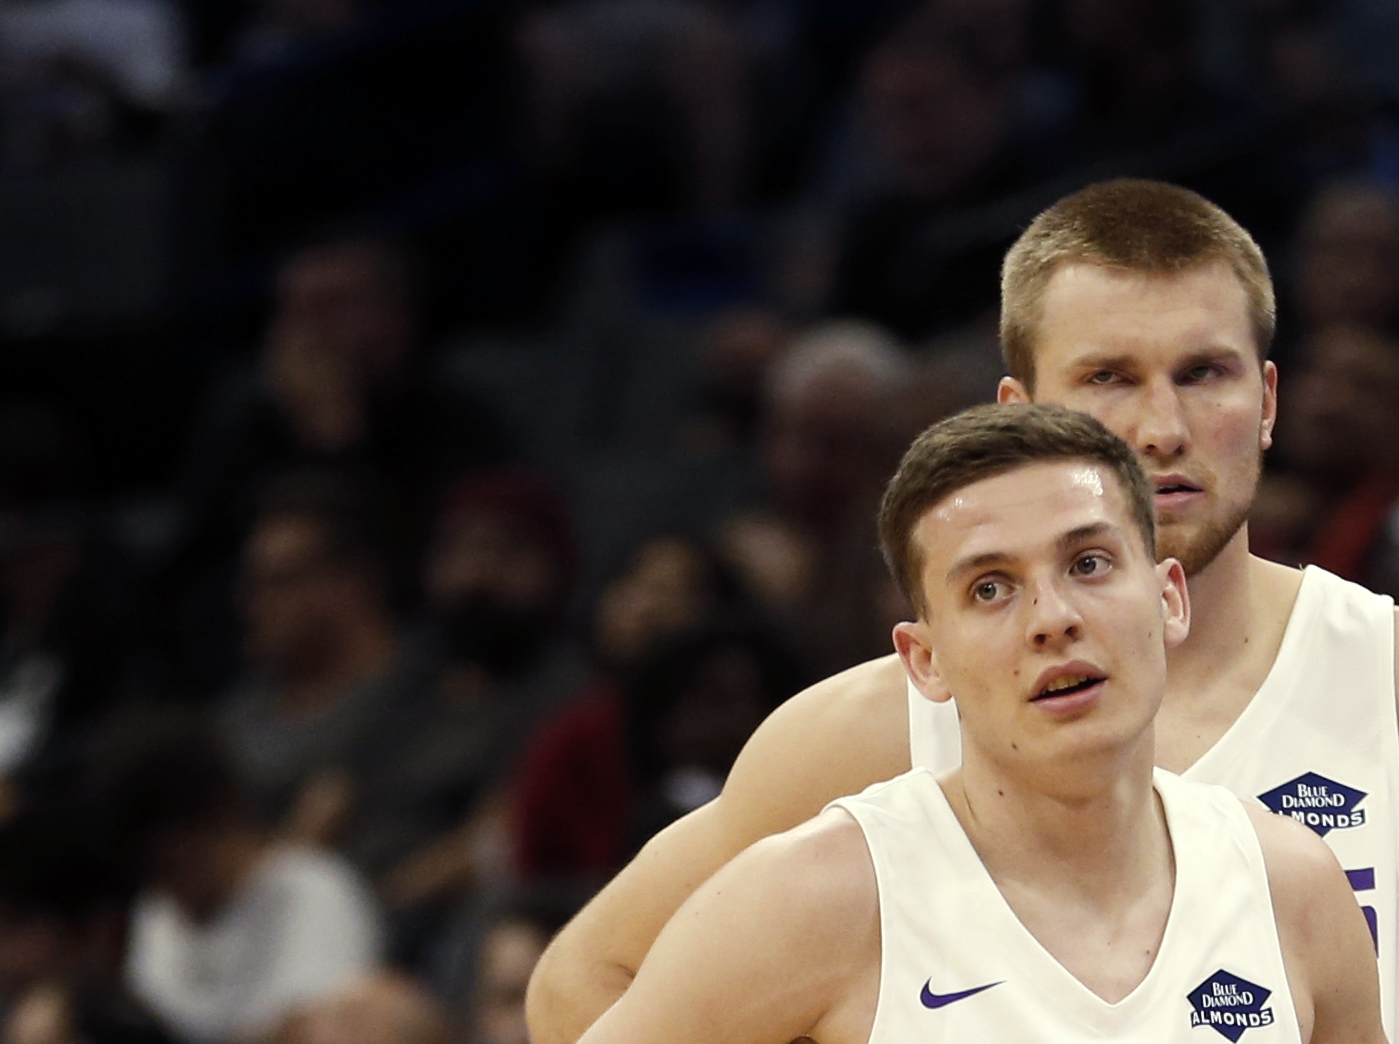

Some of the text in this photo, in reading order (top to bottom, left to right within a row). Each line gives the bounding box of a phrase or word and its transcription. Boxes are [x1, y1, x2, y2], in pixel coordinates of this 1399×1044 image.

[1297, 783, 1328, 798] BLUE
[1281, 793, 1345, 809] DIAMOND
[1278, 809, 1363, 828] MONDS
[1212, 981, 1238, 997] BLUE
[1202, 991, 1254, 1008] DIAMOND
[1192, 1009, 1272, 1027] ALMONDS
